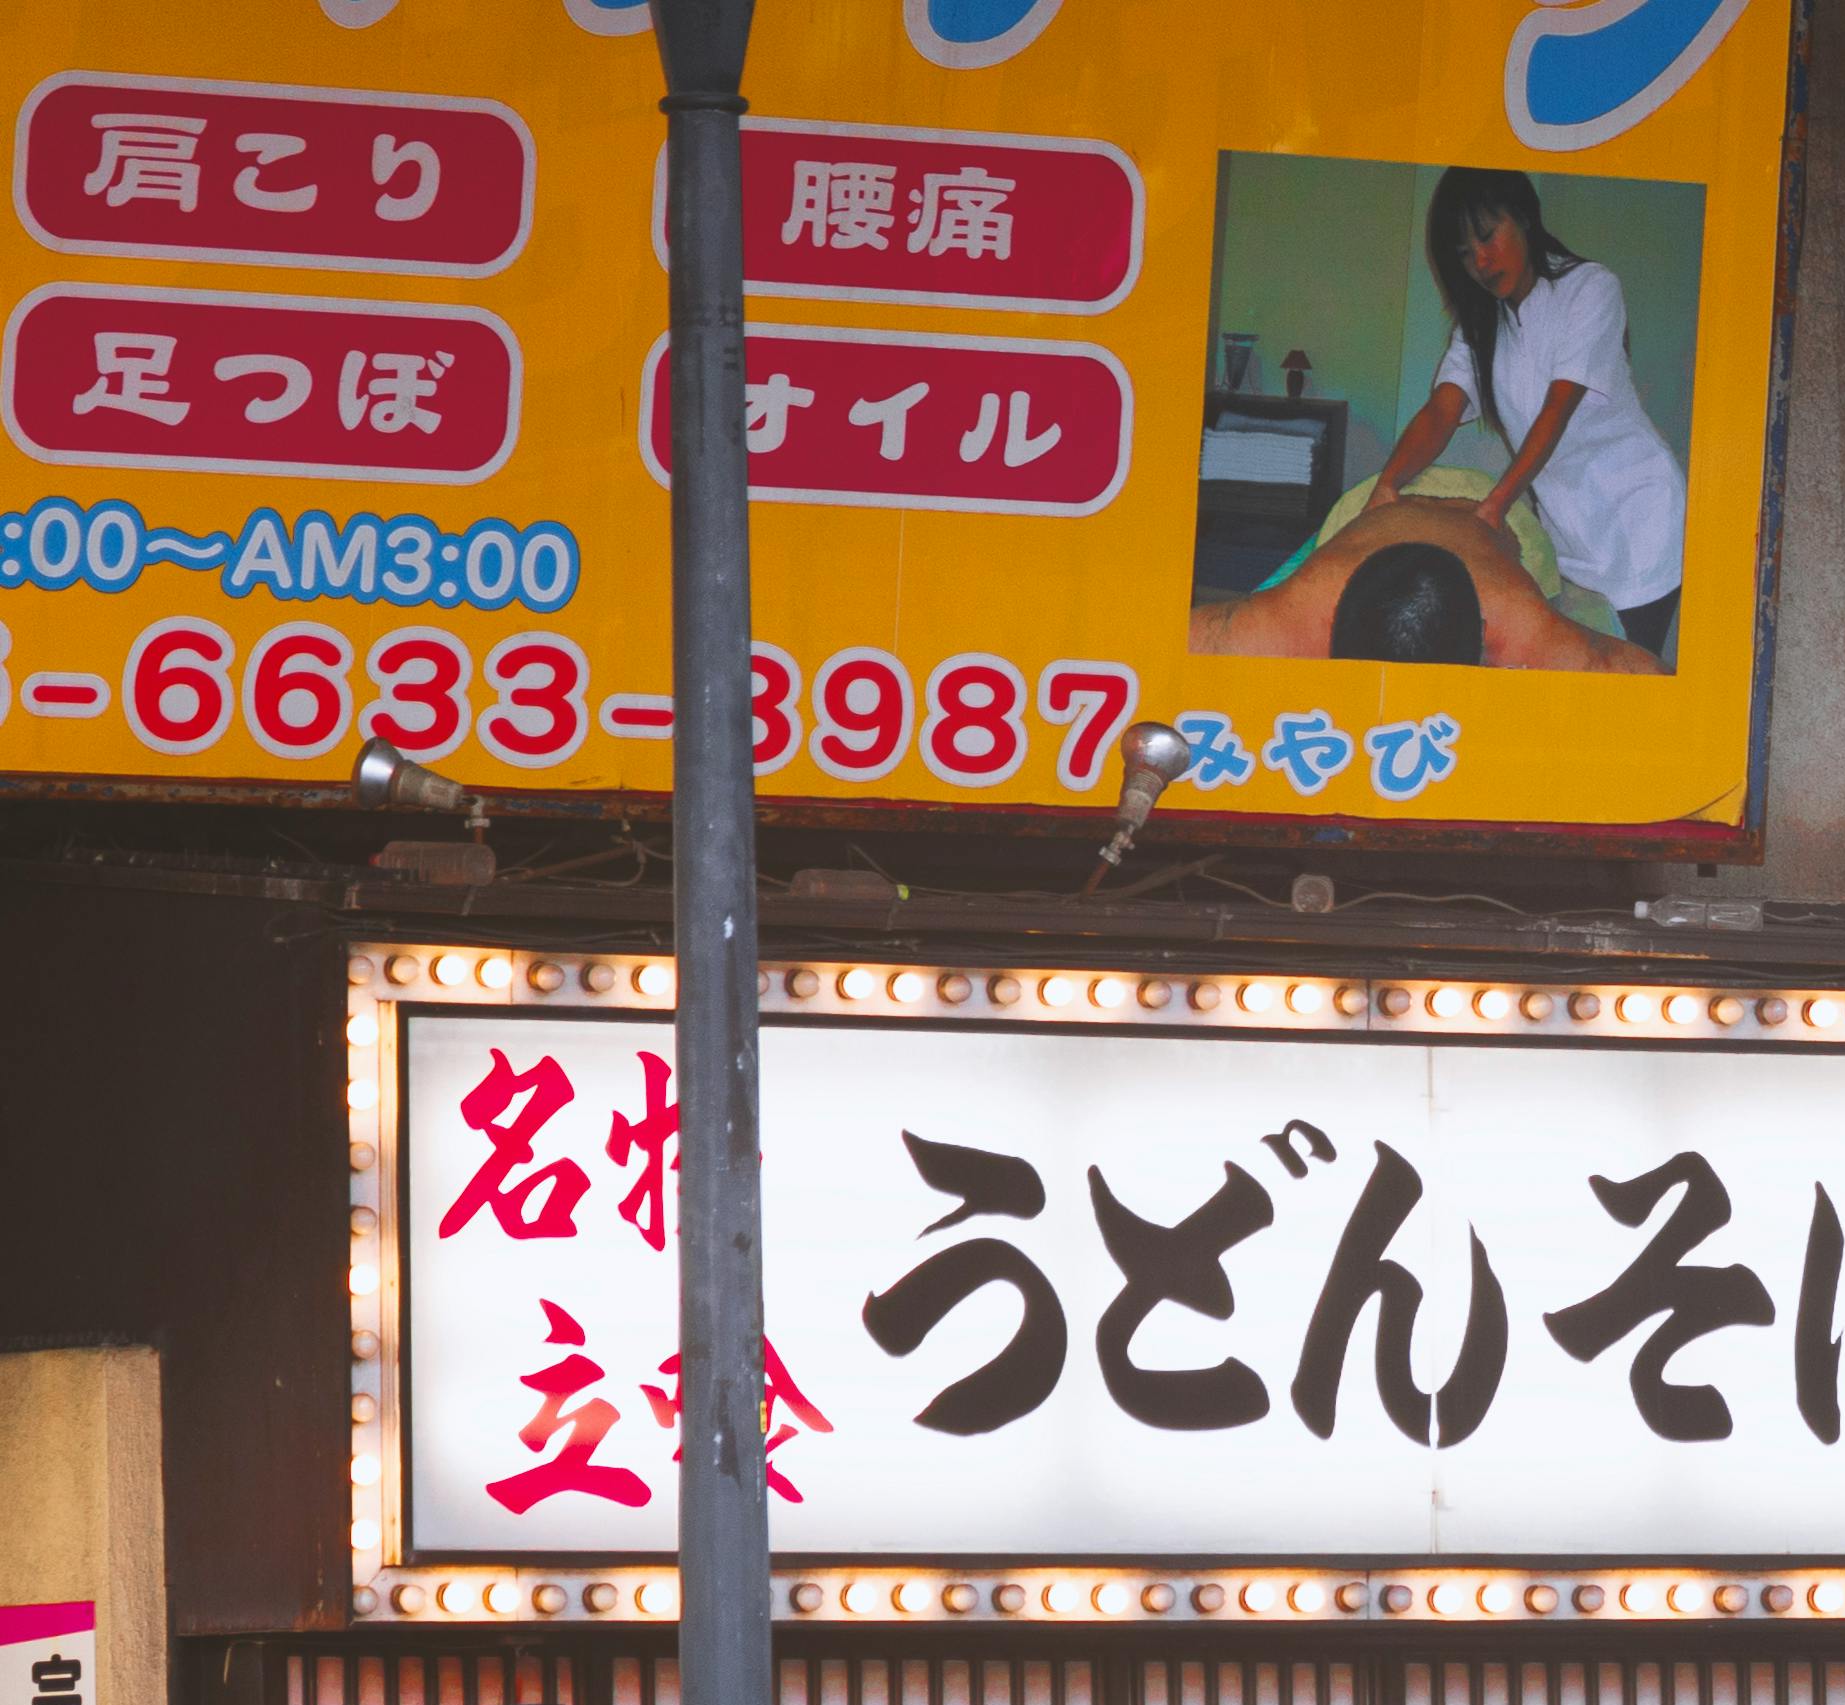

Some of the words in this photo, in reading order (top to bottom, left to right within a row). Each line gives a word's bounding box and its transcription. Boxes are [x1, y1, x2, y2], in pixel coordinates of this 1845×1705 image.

[83, 112, 442, 223] 肩こり
[781, 159, 1016, 261] 腰痛
[72, 331, 456, 434] 足つぼ
[0, 629, 1128, 778] -6633-987
[1180, 716, 1455, 793] みやび
